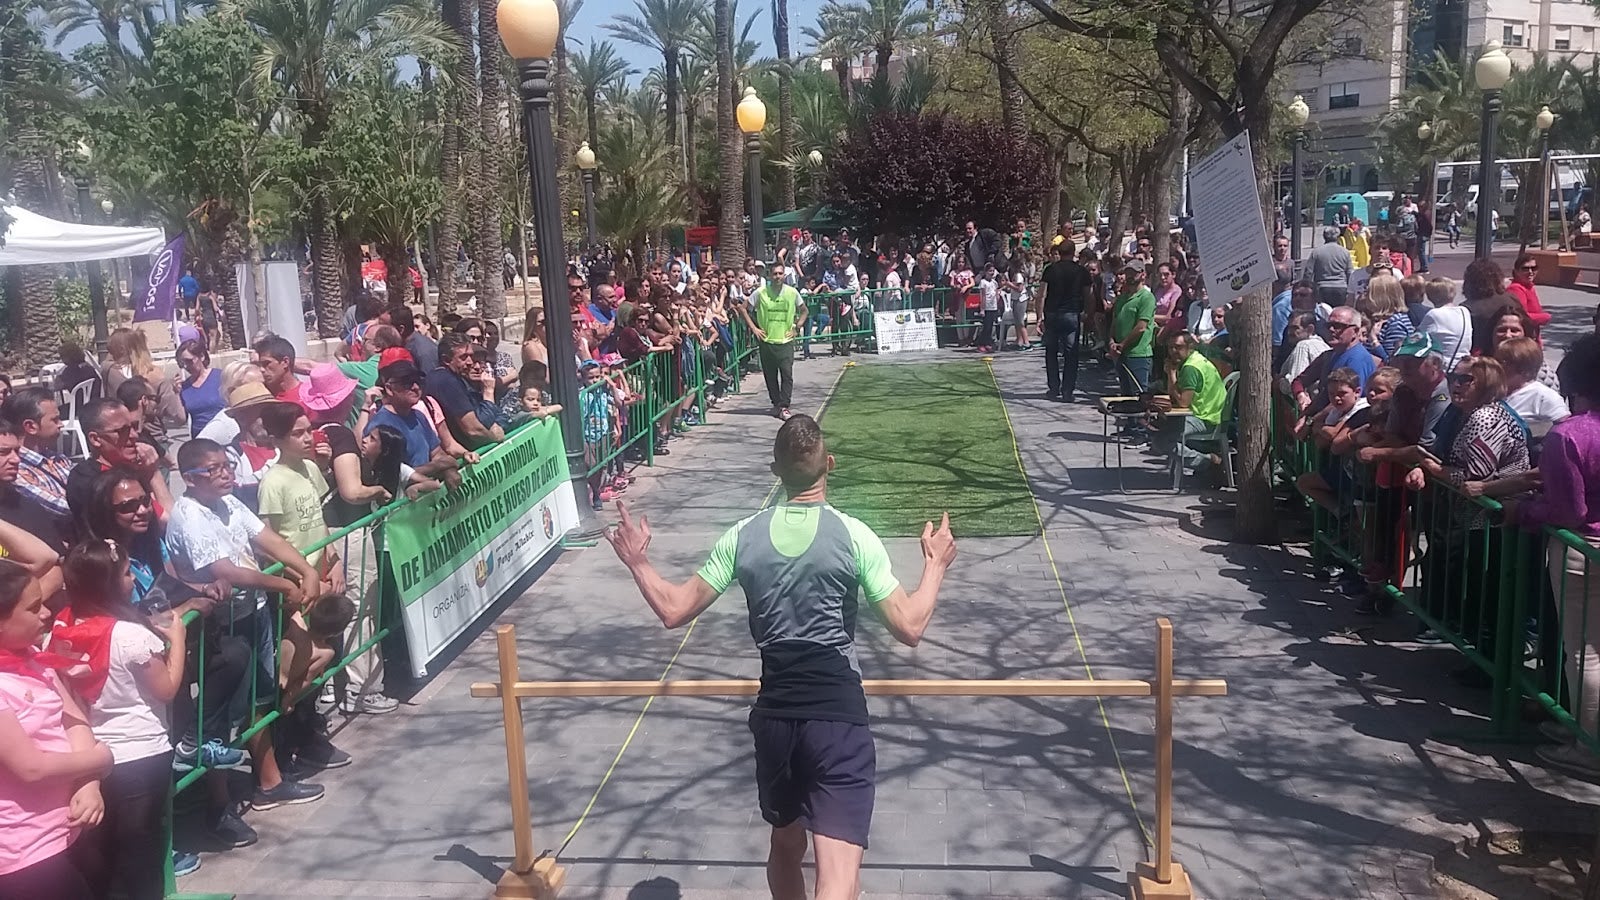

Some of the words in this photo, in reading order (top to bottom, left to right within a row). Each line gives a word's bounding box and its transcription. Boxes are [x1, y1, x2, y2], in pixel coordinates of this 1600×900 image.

[501, 437, 539, 479] MUNDIAL
[401, 555, 420, 592] DE
[421, 504, 492, 578] LANZAMIENTO
[491, 495, 506, 524] DE
[504, 476, 531, 514] HUESO
[531, 469, 541, 493] DE
